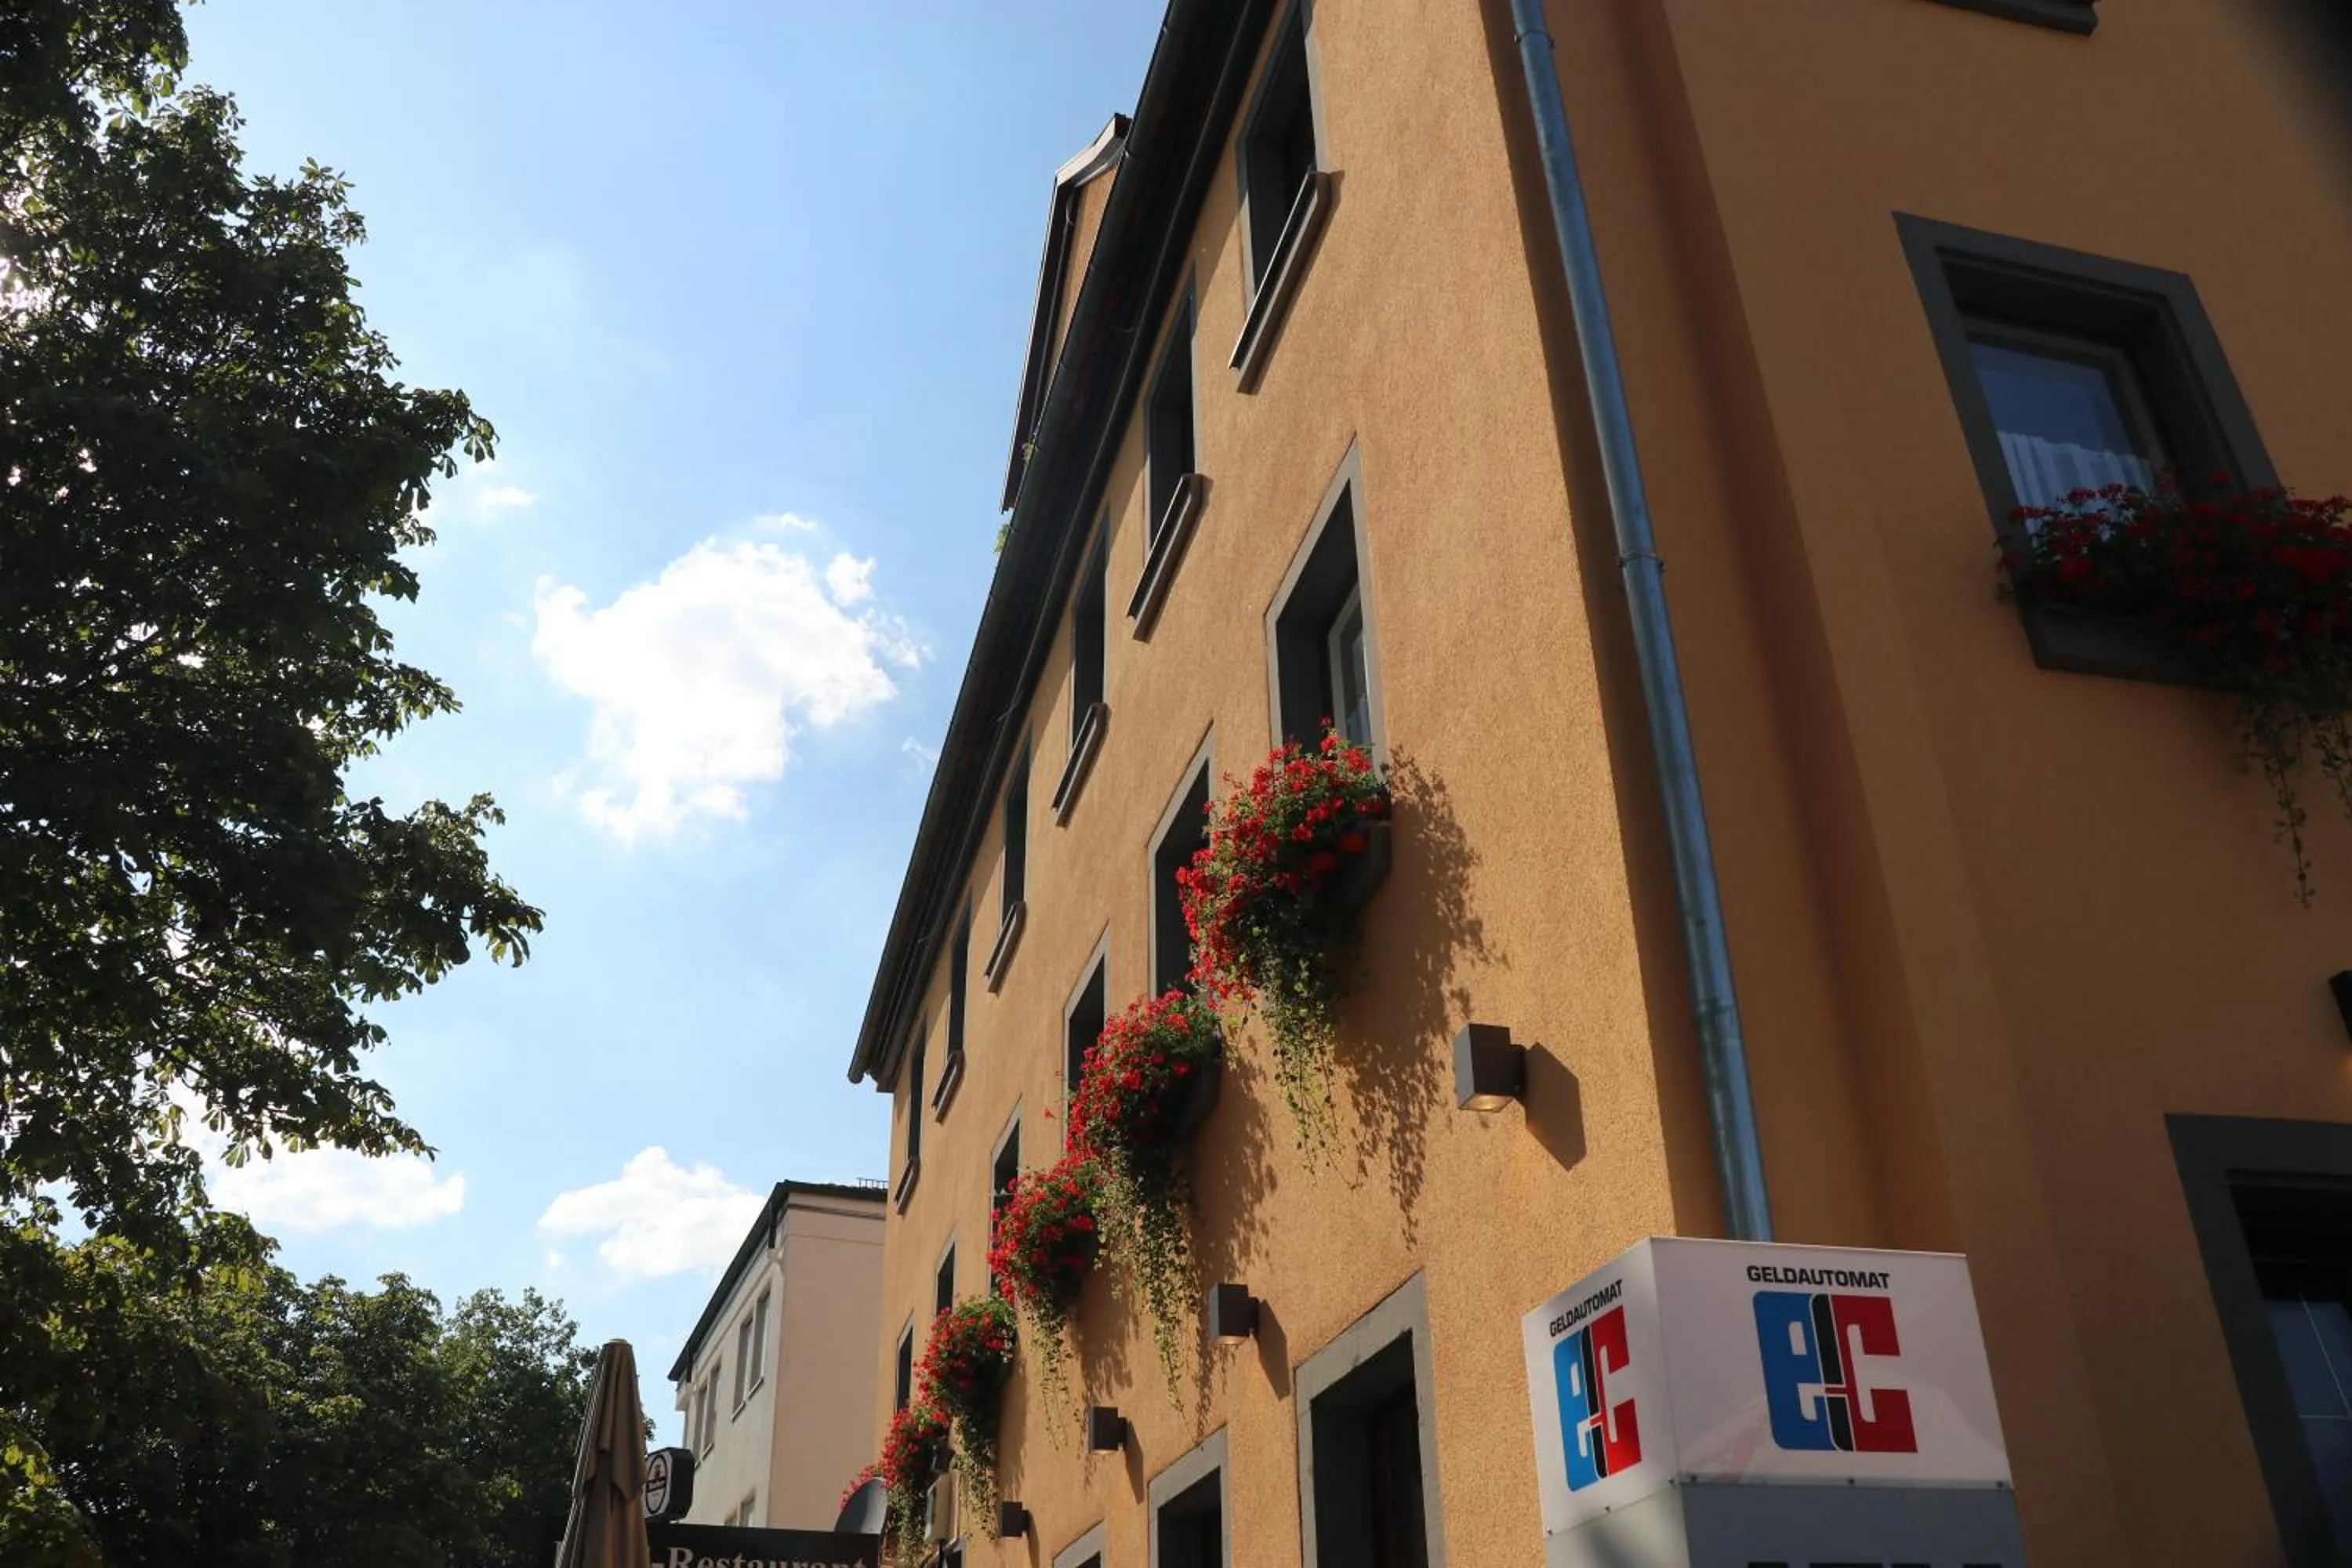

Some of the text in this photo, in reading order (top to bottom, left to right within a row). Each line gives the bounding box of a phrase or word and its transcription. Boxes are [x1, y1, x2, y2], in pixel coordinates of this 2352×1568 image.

[1747, 1265, 1891, 1290] GELDAUTOMAT
[1549, 1279, 1623, 1338] GELDAUTOMAT
[652, 1547, 866, 1568] -Restat
